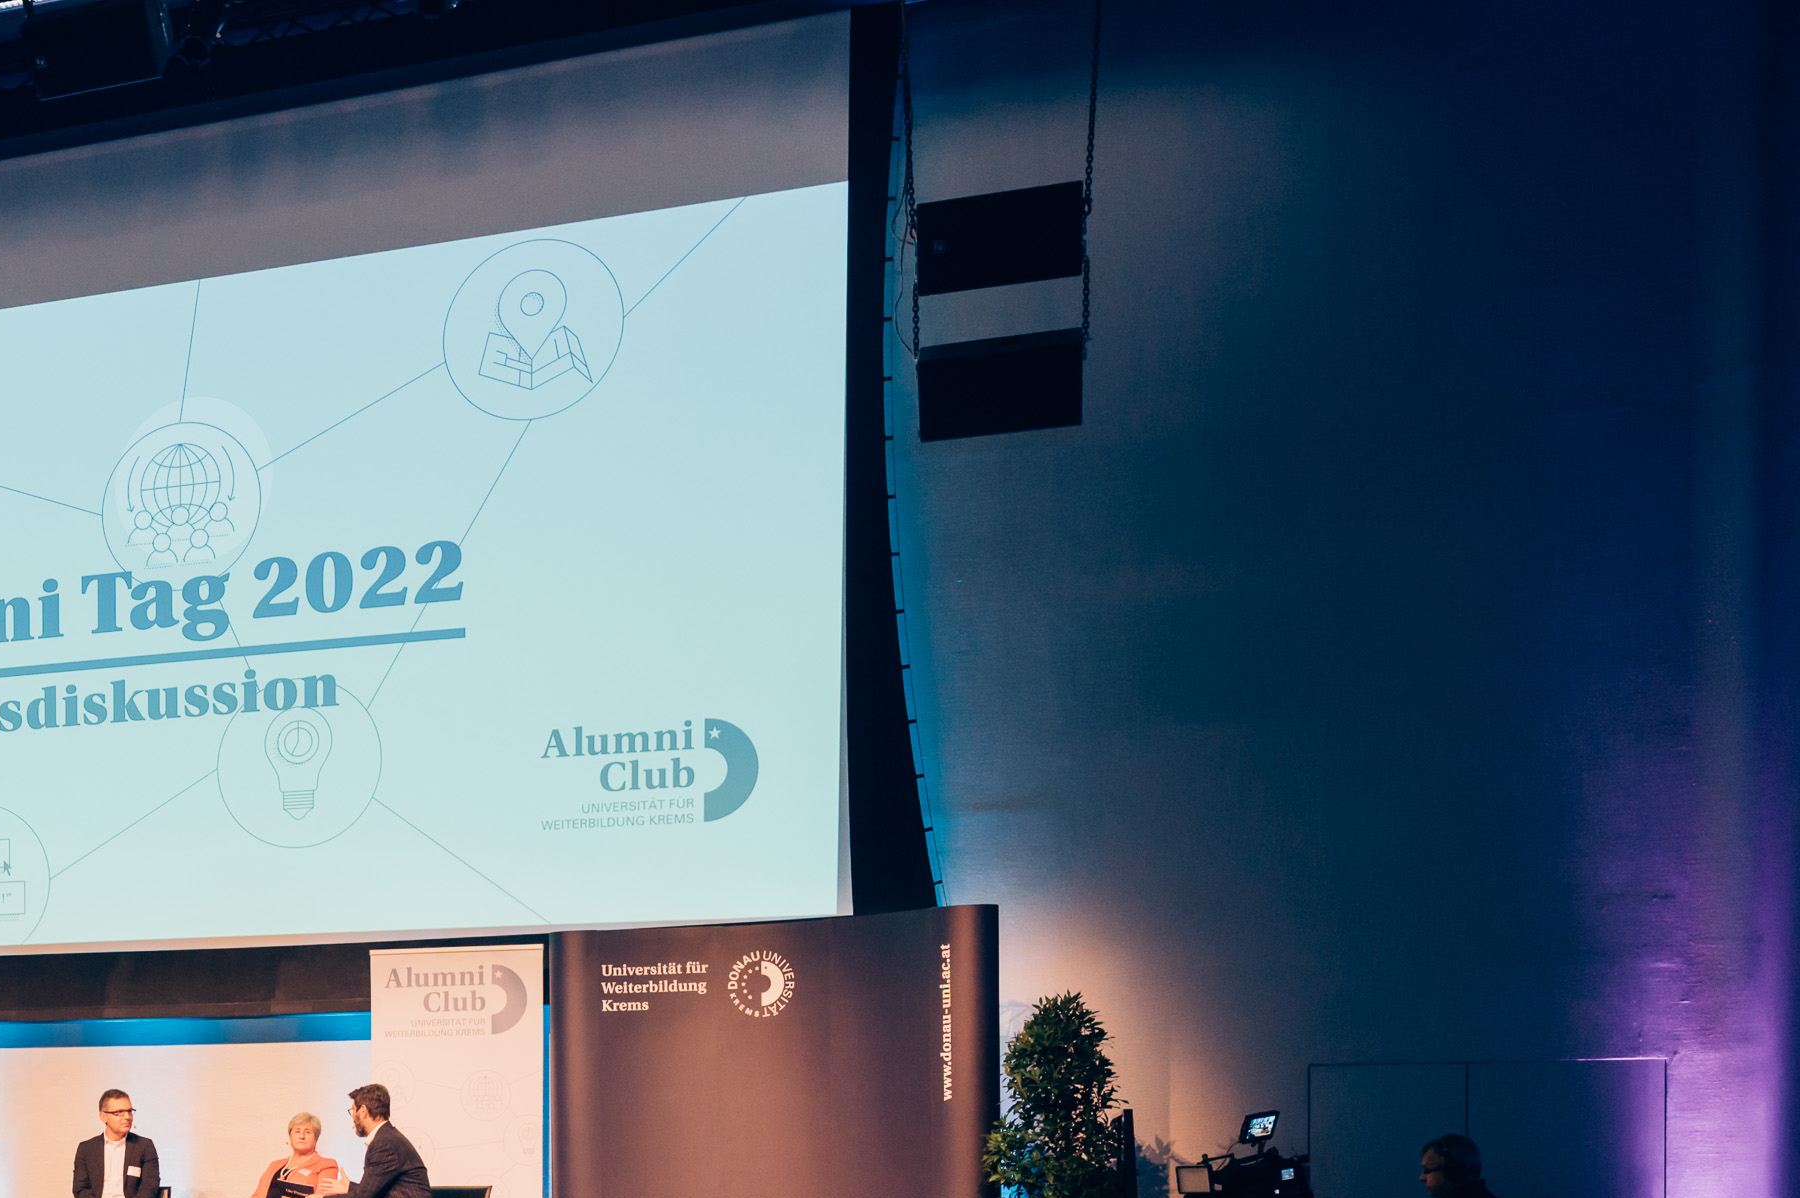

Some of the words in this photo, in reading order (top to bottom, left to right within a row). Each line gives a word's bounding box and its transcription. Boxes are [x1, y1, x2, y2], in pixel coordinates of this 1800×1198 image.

[81, 569, 230, 641] Tag
[251, 539, 464, 620] 2022
[541, 720, 694, 758] Alumni
[600, 757, 695, 792] Club
[581, 798, 665, 813] UNIVERSITÄT
[669, 796, 695, 809] FÜR
[541, 816, 645, 830] WEITERBILDUNG
[649, 813, 694, 825] KREMS
[385, 965, 485, 988] Alumni
[601, 963, 683, 977] Universität
[685, 961, 709, 974] für
[601, 980, 708, 994] Weiterbildung
[728, 950, 761, 990] DONAU
[762, 950, 795, 1018] UNIVERSITÄT
[423, 990, 486, 1013] Club
[601, 999, 649, 1012] Krems
[729, 992, 760, 1018] KREMS
[385, 1028, 453, 1038] WEITERBILDUNG
[456, 1028, 485, 1037] KREMS
[939, 943, 952, 1102] www.donau-uni.ac.at
